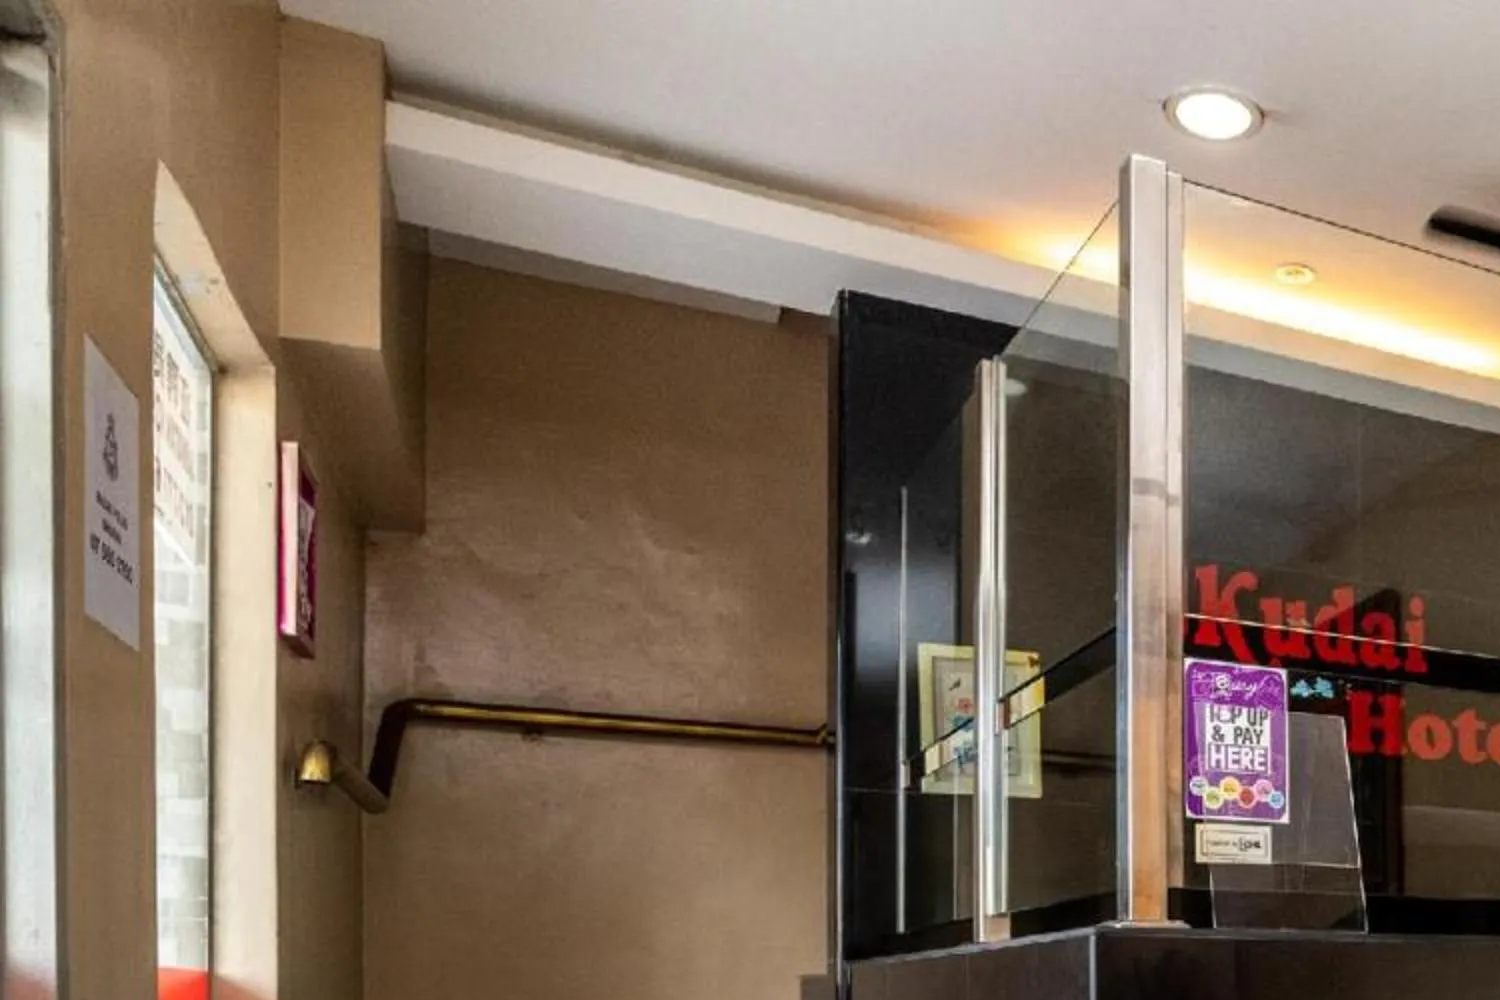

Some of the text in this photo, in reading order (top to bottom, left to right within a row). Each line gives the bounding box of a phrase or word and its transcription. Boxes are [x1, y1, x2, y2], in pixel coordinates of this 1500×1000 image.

[1194, 564, 1428, 674] Kudai
[1246, 706, 1268, 727] UP
[1212, 725, 1263, 745] & PAY
[1209, 744, 1267, 771] HERE
